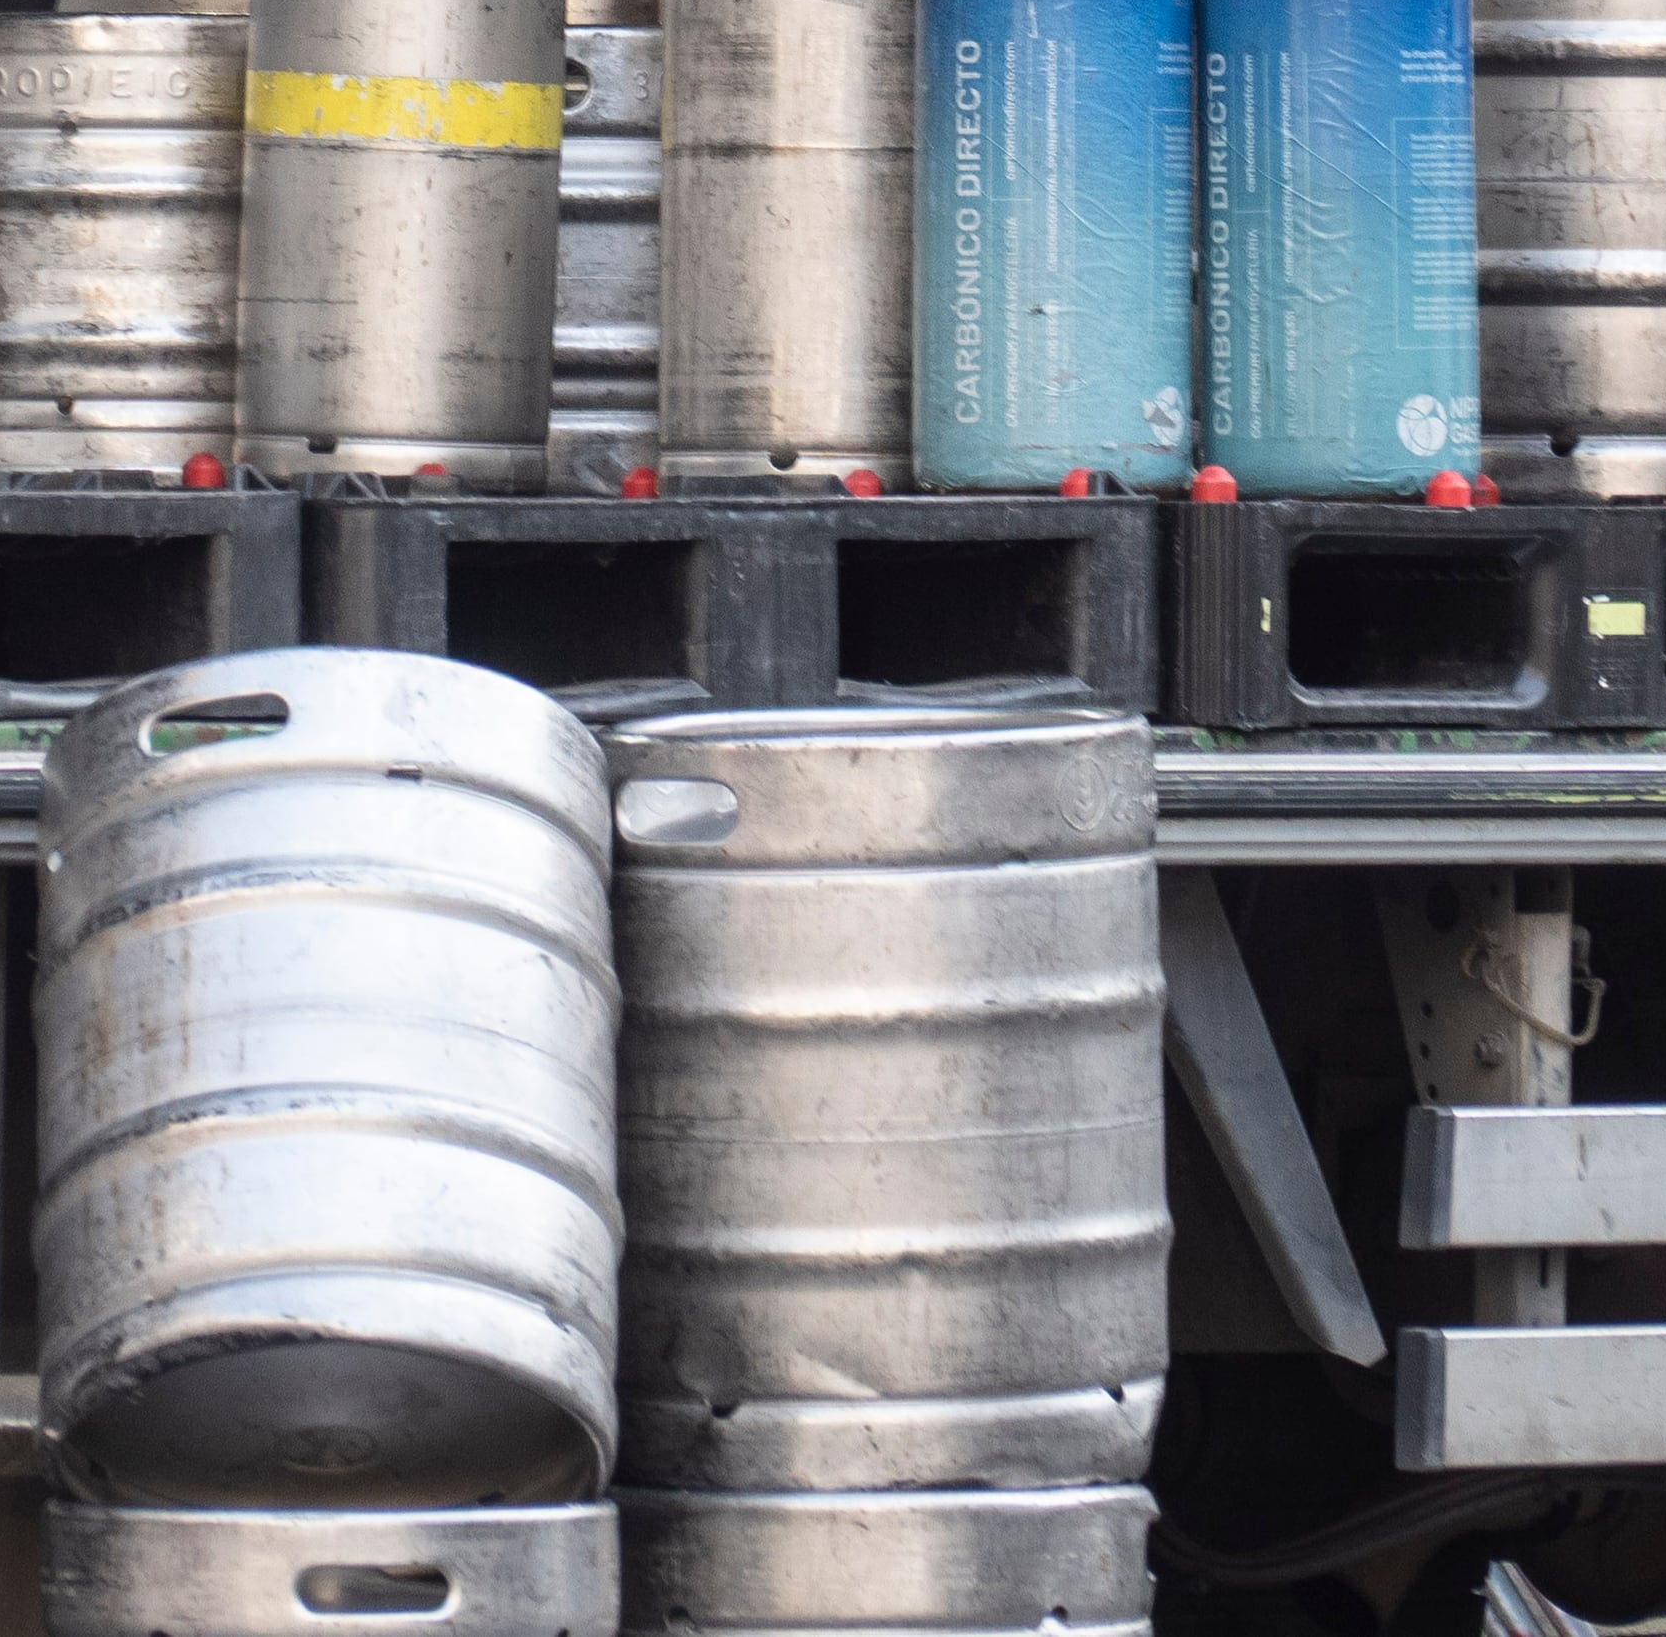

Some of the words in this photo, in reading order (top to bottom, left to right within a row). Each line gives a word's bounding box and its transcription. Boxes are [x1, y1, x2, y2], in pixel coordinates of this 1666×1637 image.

[954, 39, 981, 198] DIRECTO
[1206, 52, 1230, 210] DIRECTO
[950, 207, 981, 425] CARBÓNICO
[1210, 220, 1233, 436] CARBÓNICO
[1247, 313, 1260, 350] PARA
[1248, 351, 1261, 413] PREMIUM
